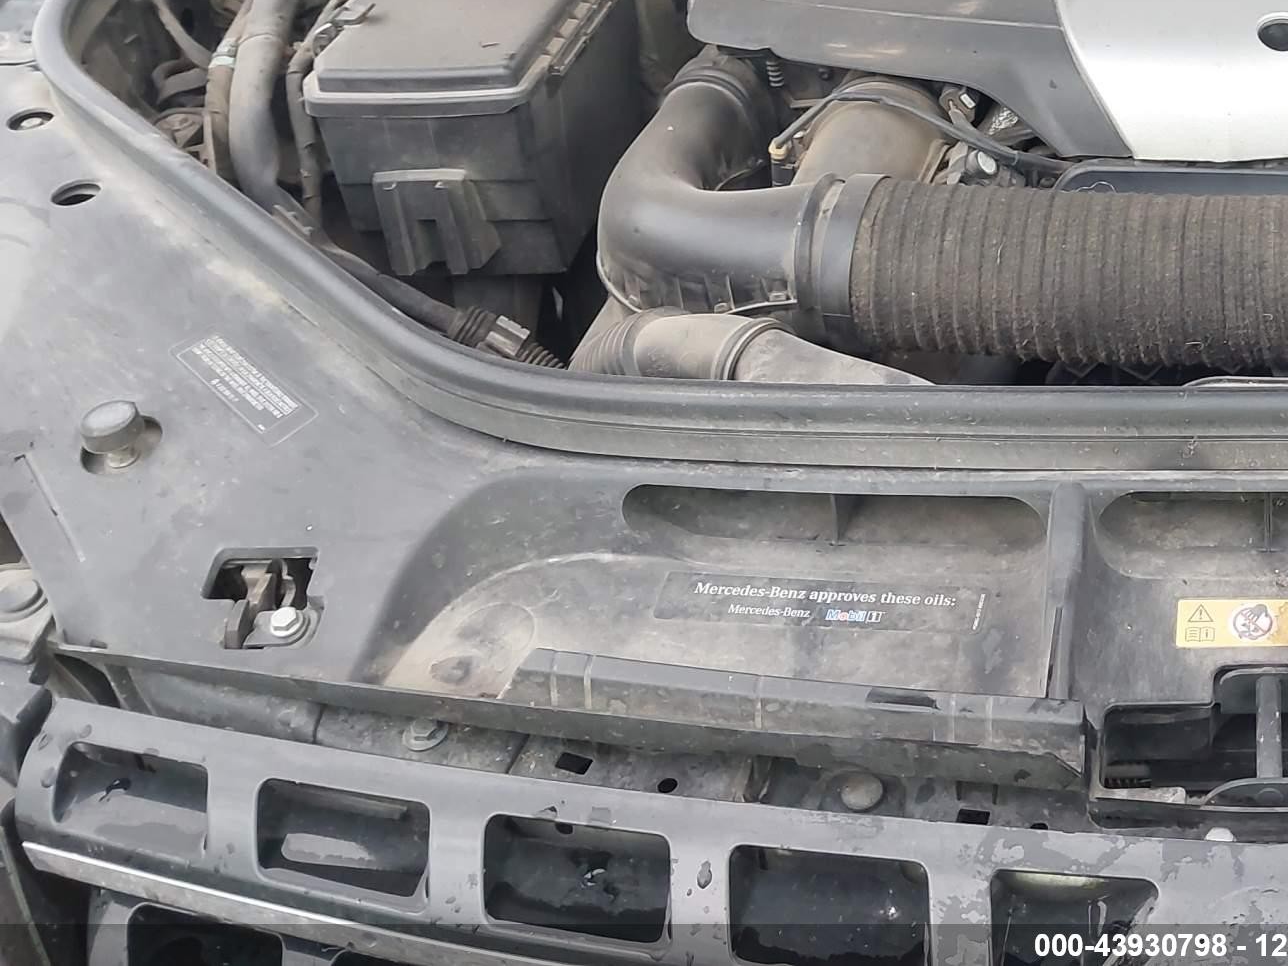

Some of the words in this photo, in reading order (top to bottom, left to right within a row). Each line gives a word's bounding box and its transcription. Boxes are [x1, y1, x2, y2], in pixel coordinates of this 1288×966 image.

[694, 582, 807, 599] Mercedes-Benz
[809, 590, 876, 604] approves
[880, 591, 920, 605] these
[924, 594, 956, 607] oils:
[727, 603, 811, 618] Mercedes-Benz
[825, 609, 866, 622] Mobil
